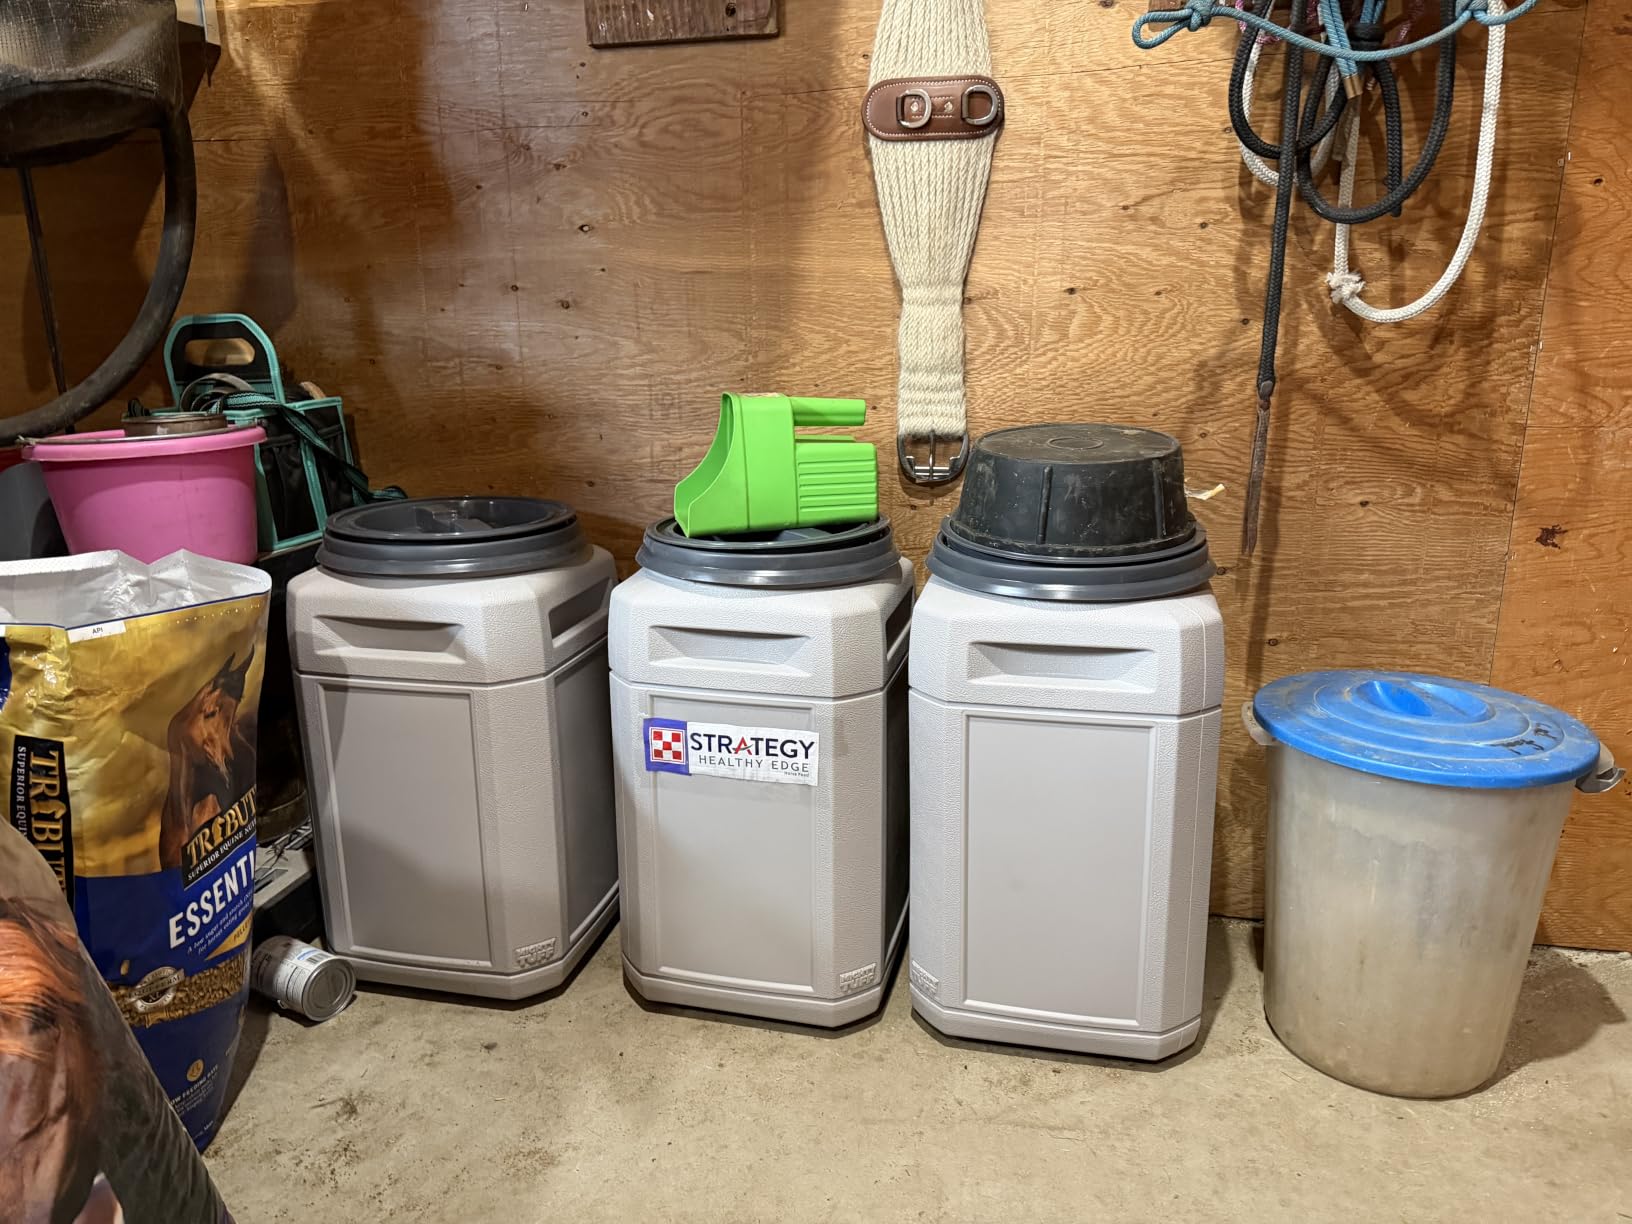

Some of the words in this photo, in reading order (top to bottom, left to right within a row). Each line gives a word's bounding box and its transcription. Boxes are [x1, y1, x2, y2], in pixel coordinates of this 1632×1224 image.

[690, 732, 815, 759] STRATEGY
[699, 755, 763, 768] HEALTHY
[772, 760, 809, 773] EDGE
[16, 746, 27, 802] SUPERIOR
[188, 851, 220, 880] SUPERIOR
[220, 830, 243, 853] EQUINE
